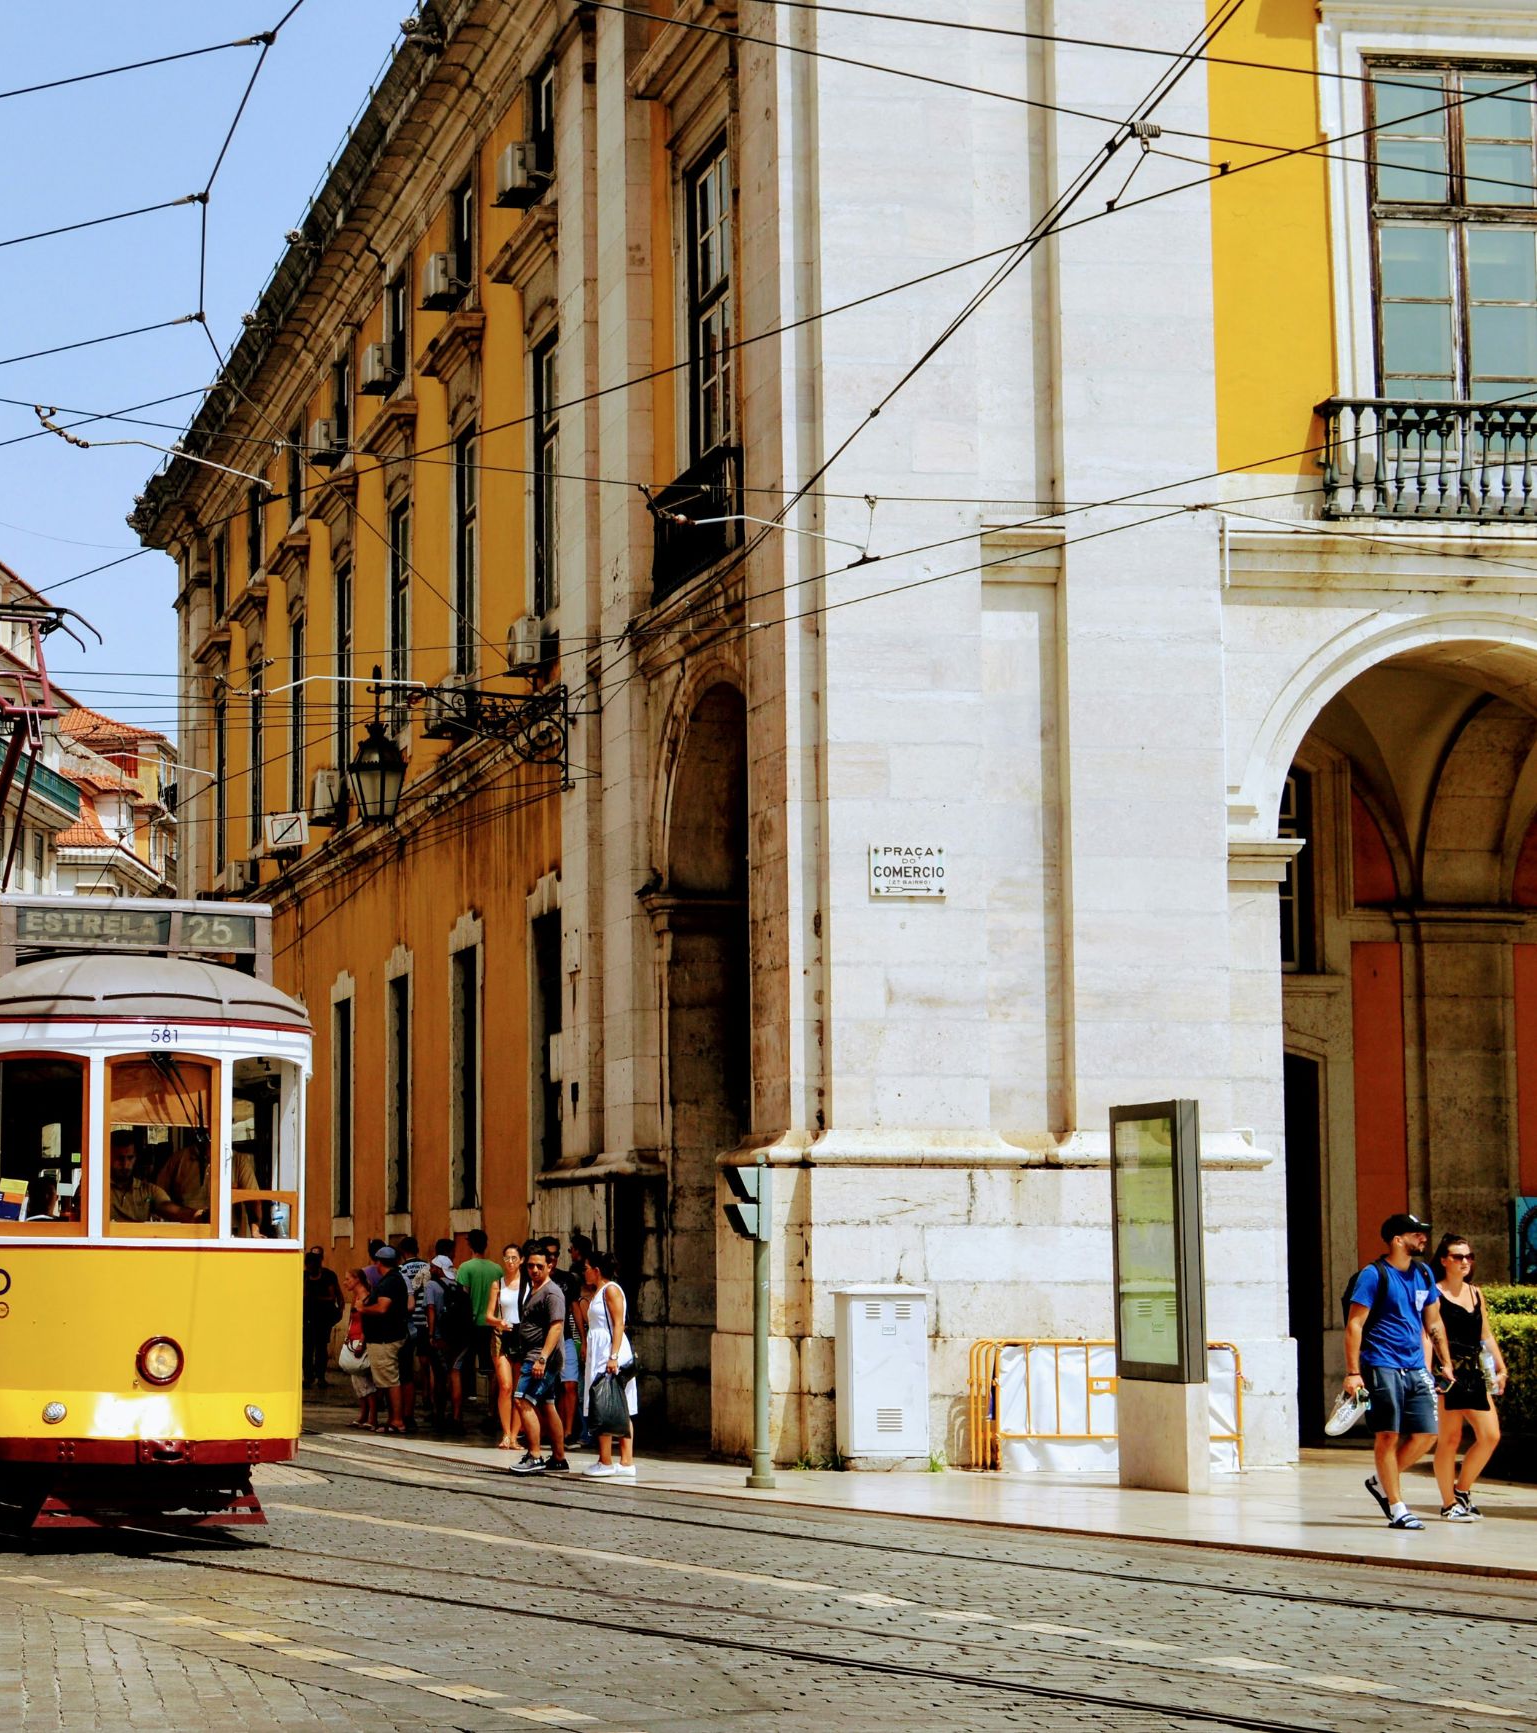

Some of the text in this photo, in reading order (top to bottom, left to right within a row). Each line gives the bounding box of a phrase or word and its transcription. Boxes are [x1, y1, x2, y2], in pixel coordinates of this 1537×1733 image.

[883, 847, 934, 859] PRAÇA
[873, 866, 945, 878] COMERCIO
[25, 911, 159, 936] ESTRELA
[188, 915, 233, 945] 25
[150, 1029, 178, 1043] 581
